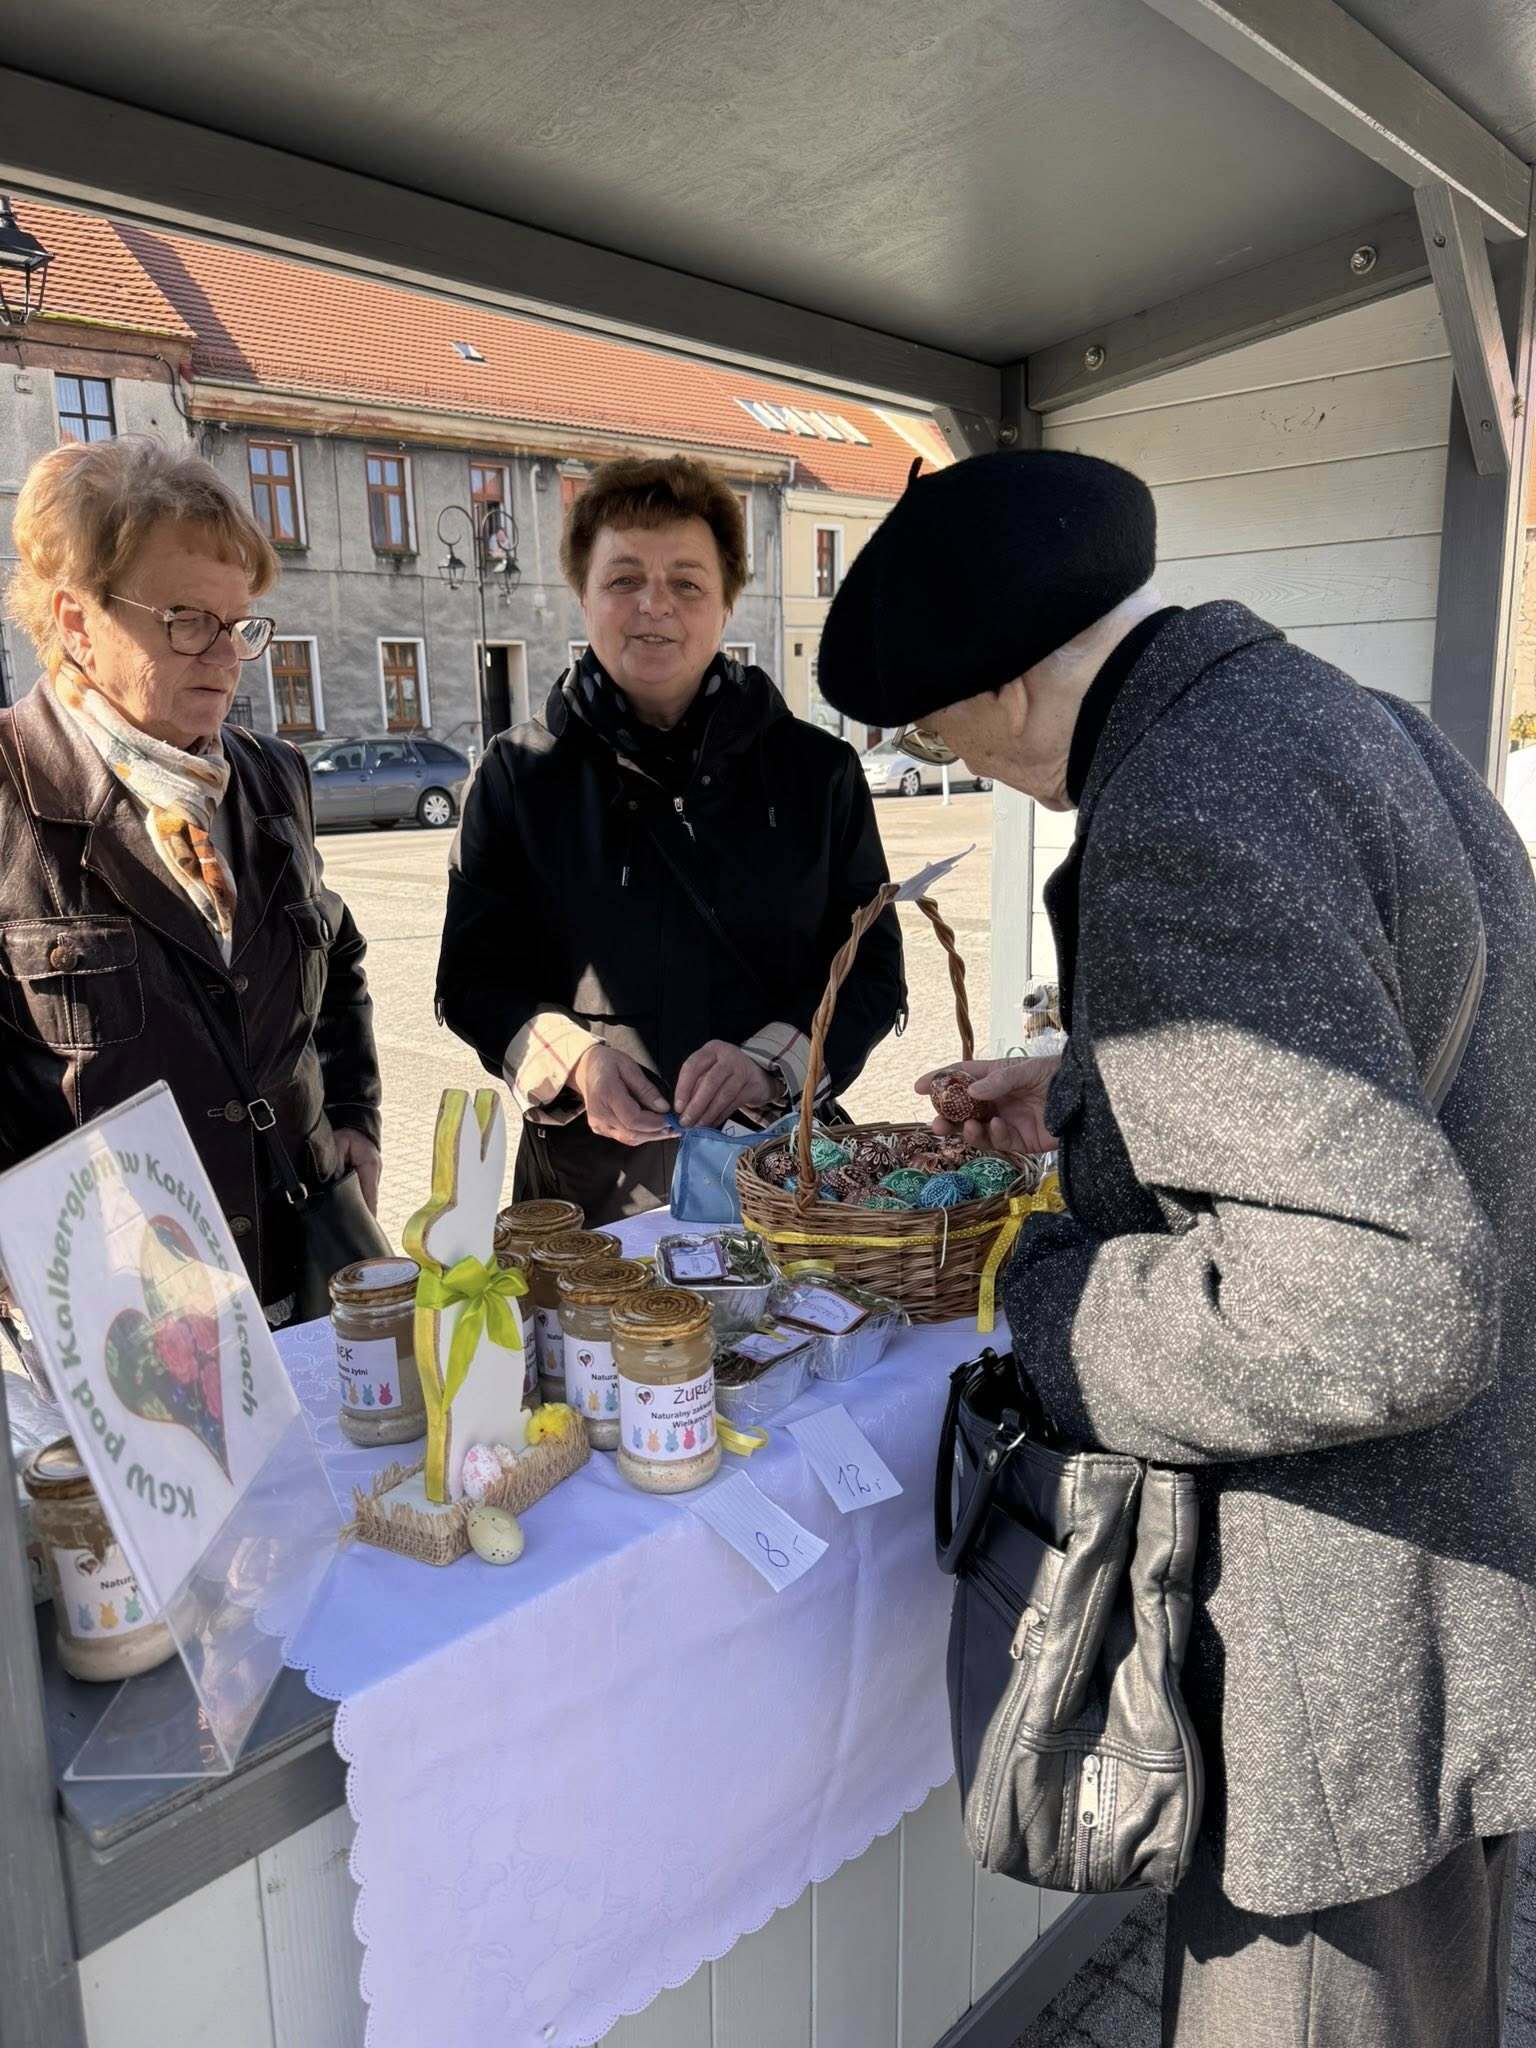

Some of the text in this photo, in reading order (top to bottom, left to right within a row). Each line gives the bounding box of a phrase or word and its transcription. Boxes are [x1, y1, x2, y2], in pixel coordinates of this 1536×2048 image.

[117, 1150, 140, 1174] w
[591, 1373, 618, 1381] Natura
[72, 1378, 126, 1464] pod
[651, 1409, 691, 1420] Naturalny
[126, 1463, 197, 1518] KGW
[100, 1575, 136, 1590] Natur
